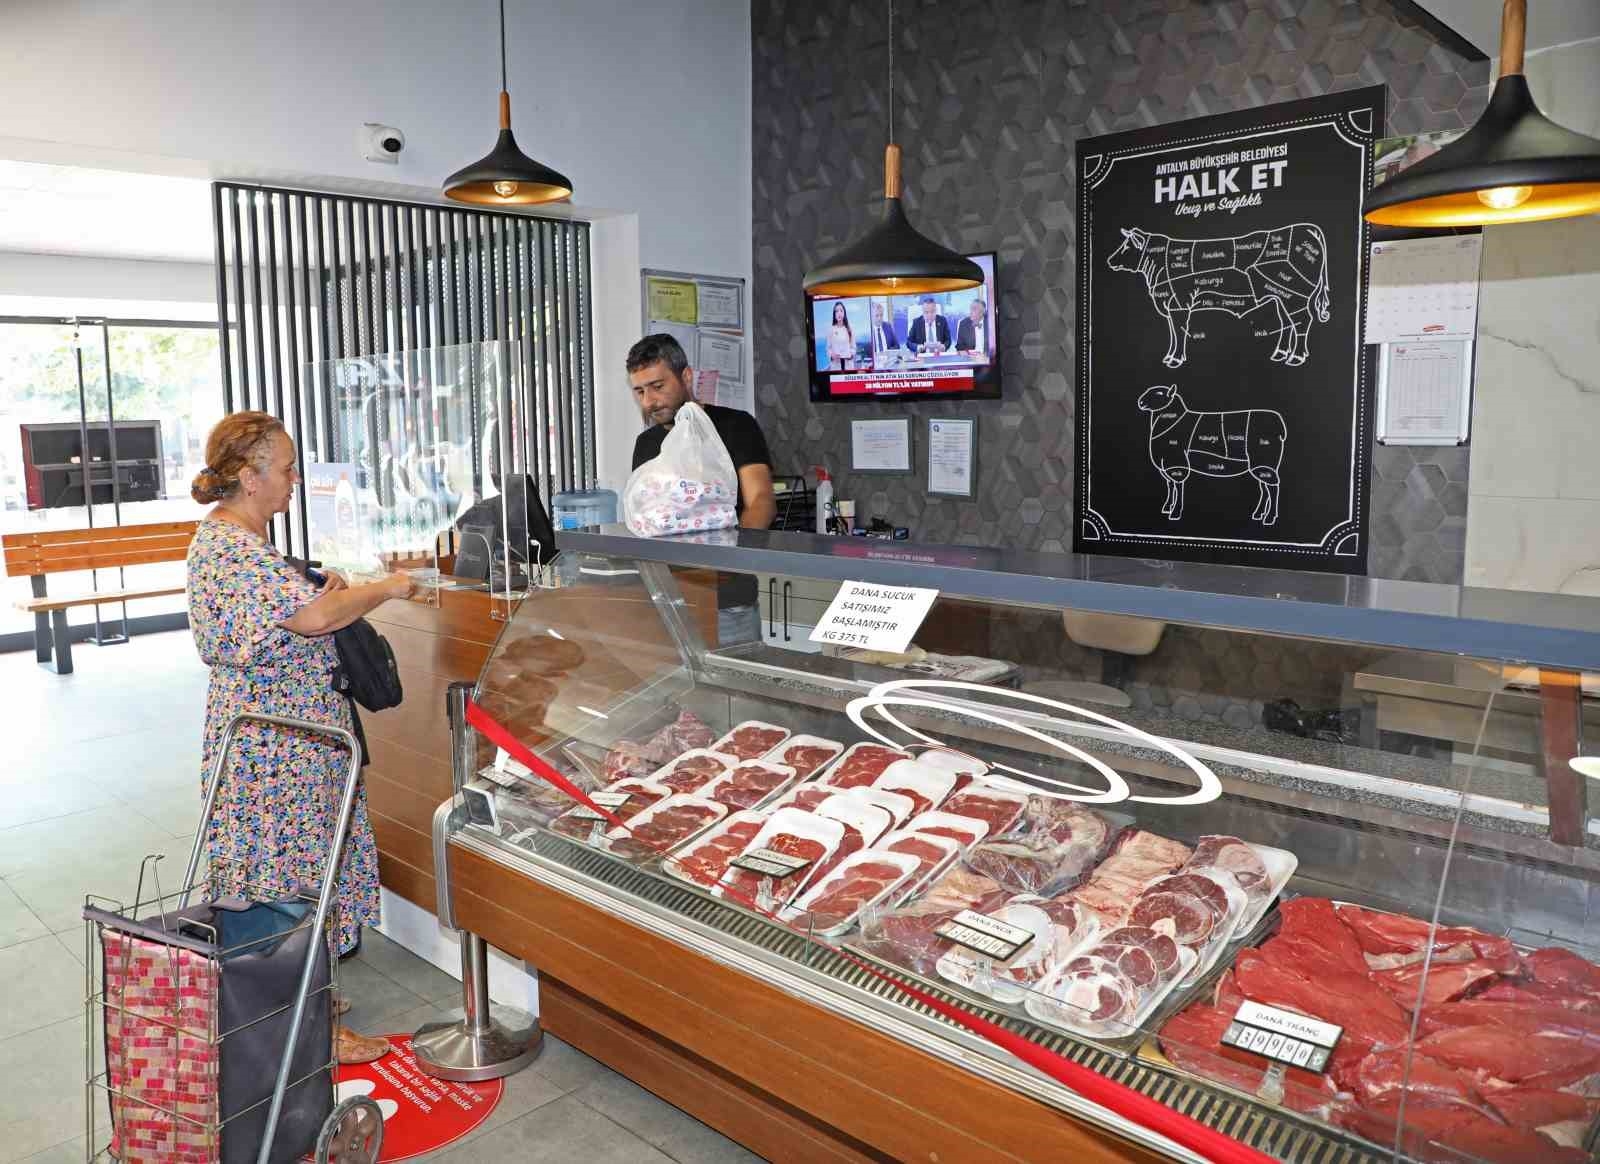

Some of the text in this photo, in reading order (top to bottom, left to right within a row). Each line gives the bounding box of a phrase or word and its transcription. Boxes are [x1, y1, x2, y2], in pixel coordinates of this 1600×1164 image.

[1155, 142, 1288, 176] ANTALYA BÜYÜKŞEHİR BELEDİYESİ
[1154, 160, 1288, 204] HALK ET
[1175, 193, 1262, 218] Ucuz ve Sağlıklı
[1194, 277, 1224, 288] Kaburga
[850, 587, 916, 601] DANA SUCUK
[840, 601, 892, 615] SATIŞIMIZ
[831, 616, 898, 631] BAŞLAMIŞTIR
[821, 631, 870, 645] KG 375 TL
[1255, 1012, 1284, 1026] DANA
